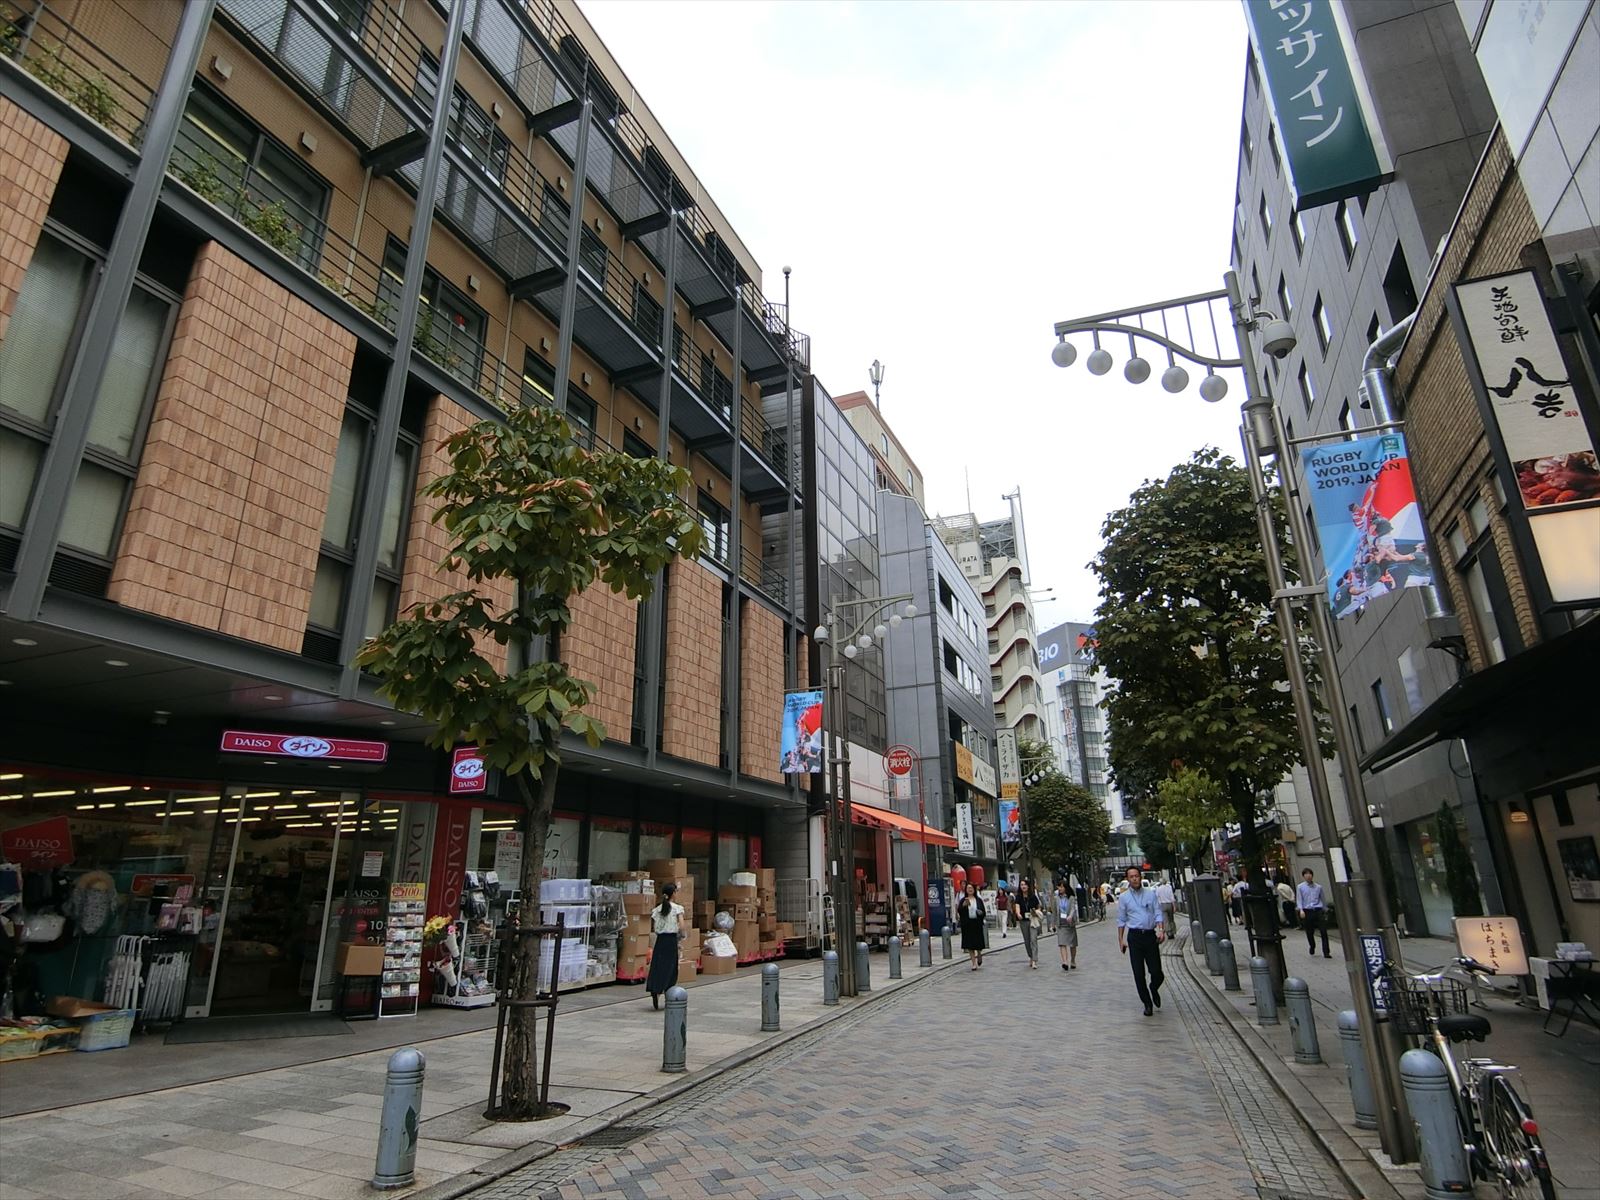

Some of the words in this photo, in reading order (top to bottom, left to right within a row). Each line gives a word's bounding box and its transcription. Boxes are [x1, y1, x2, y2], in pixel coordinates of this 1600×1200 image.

[1312, 450, 1362, 468] RUGBY
[1313, 461, 1369, 478] WORLD
[1371, 452, 1399, 470] CUP
[1316, 476, 1355, 490] 2019,
[1357, 462, 1401, 484] JAPAN
[235, 737, 272, 748] DAISO
[289, 741, 328, 752] ダイソー
[890, 756, 911, 768] 消火栓
[459, 763, 483, 774] ダイソ
[458, 780, 478, 788] DAISO
[15, 838, 60, 849] DAISO
[444, 824, 464, 908] DAISO
